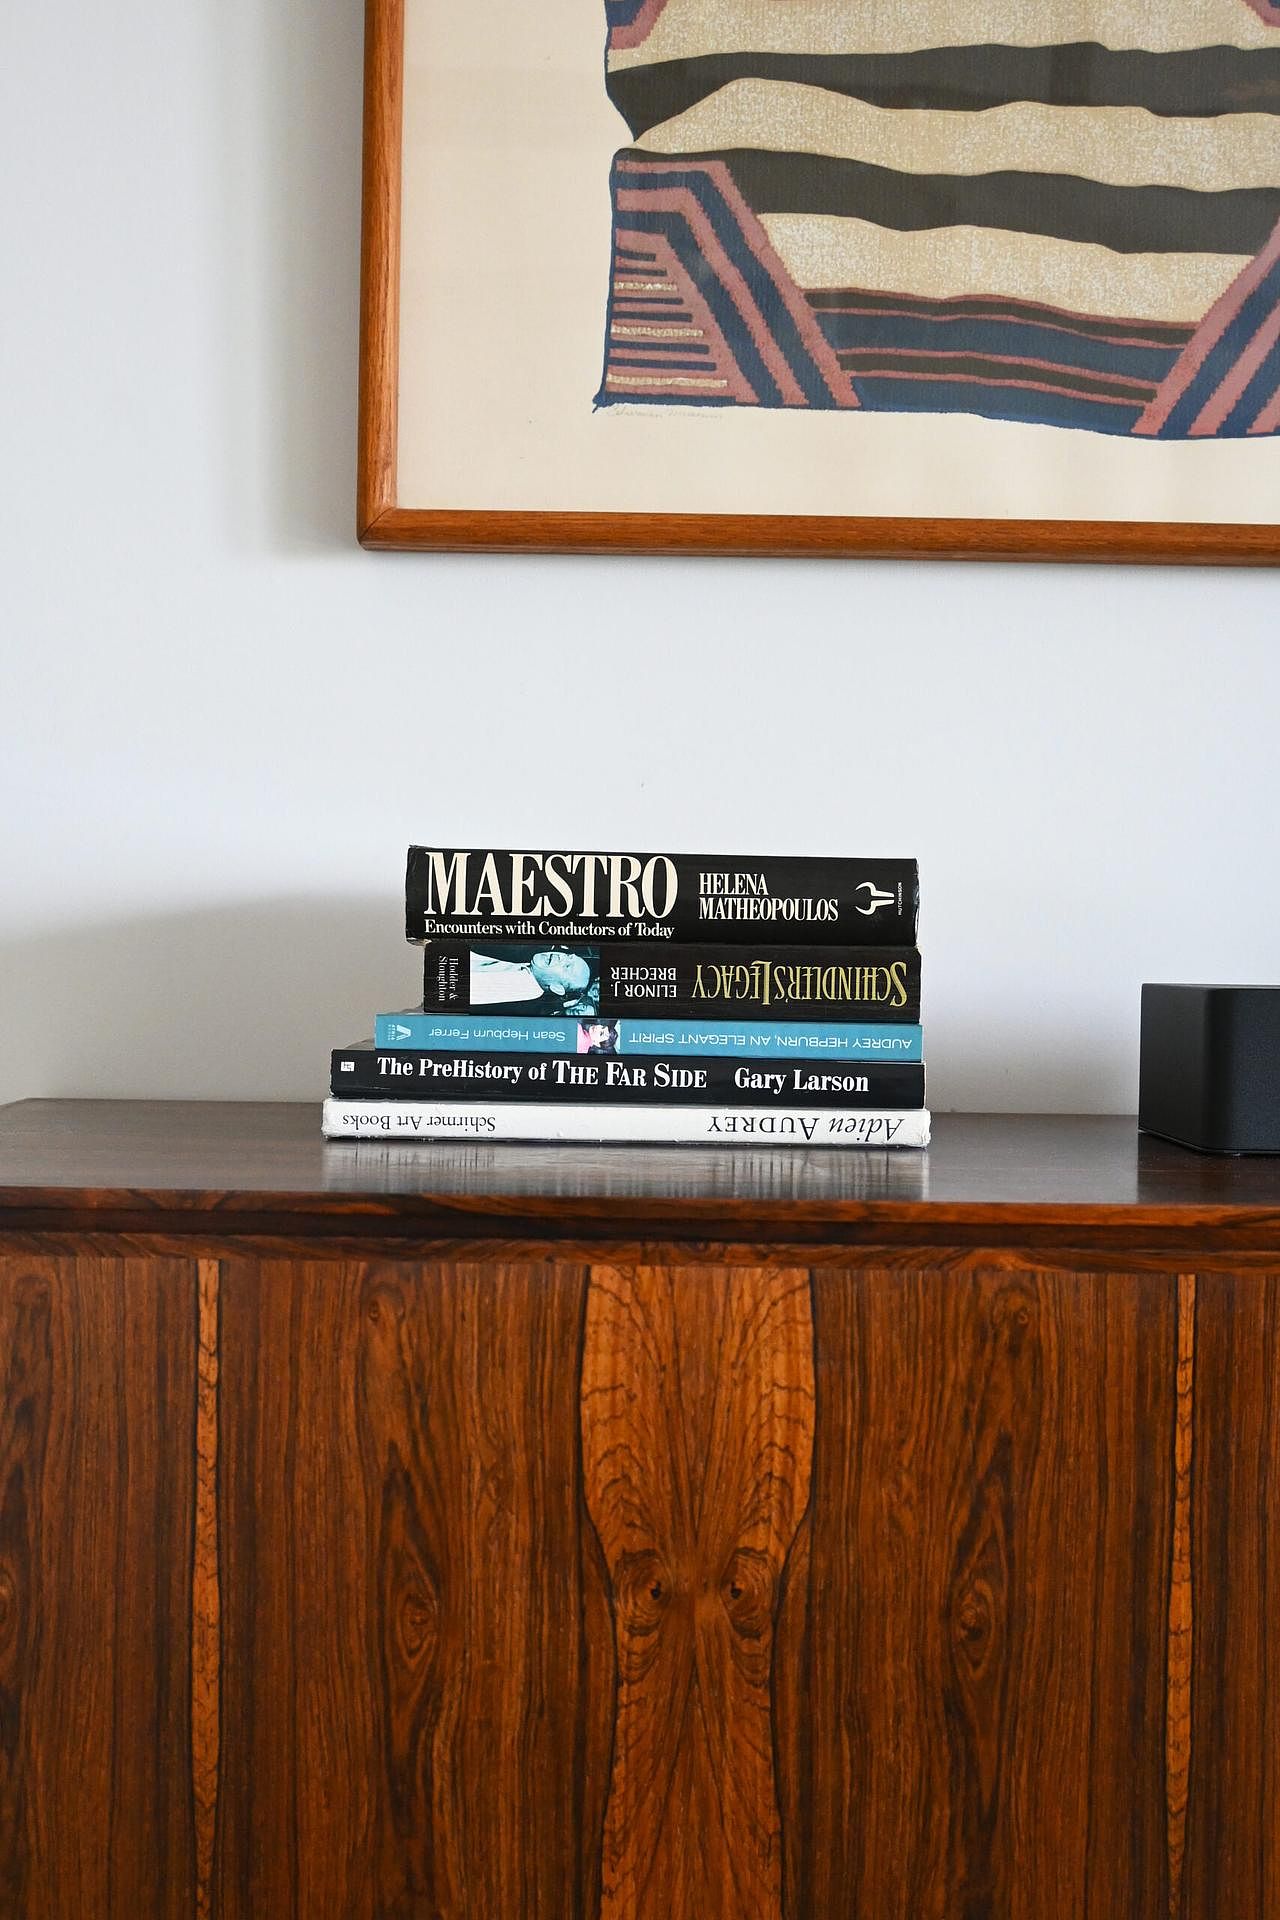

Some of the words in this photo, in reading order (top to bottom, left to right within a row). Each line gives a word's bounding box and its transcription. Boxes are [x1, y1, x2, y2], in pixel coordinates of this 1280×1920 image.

[424, 852, 679, 918] MAESTRO
[699, 873, 769, 896] HELENA
[699, 897, 839, 921] MATHEOPOULOS
[424, 919, 503, 935] Encounters
[505, 921, 536, 936] with
[538, 921, 616, 937] Conductors
[618, 922, 633, 937] of
[634, 922, 675, 939] Today
[436, 955, 448, 1001] Stoughton
[449, 958, 459, 990] Hodder
[610, 967, 677, 980] BRECHER
[449, 992, 459, 1000] &
[610, 981, 621, 997] J.
[624, 984, 677, 997] ELINOR
[429, 1028, 470, 1041] Ferrer
[472, 1028, 529, 1042] Hepburn
[532, 1030, 566, 1042] Sean
[629, 1032, 675, 1044] SPIRIT
[677, 1034, 746, 1046] ELEGANT
[751, 1035, 771, 1047] AN
[775, 1036, 848, 1048] HEPBURN,
[852, 1038, 913, 1049] AUDREY
[377, 1057, 413, 1076] The
[418, 1058, 523, 1084] PreHistory
[528, 1063, 548, 1081] of
[552, 1060, 599, 1085] THE
[605, 1061, 647, 1087] FAR
[653, 1063, 708, 1089] SIDE
[734, 1067, 787, 1094] Gary
[793, 1069, 870, 1092] Larson
[342, 1114, 390, 1131] Books
[396, 1114, 422, 1131] Art
[426, 1115, 496, 1132] Schirmer
[706, 1116, 820, 1141] AUDREY
[828, 1118, 905, 1142] Adieu
